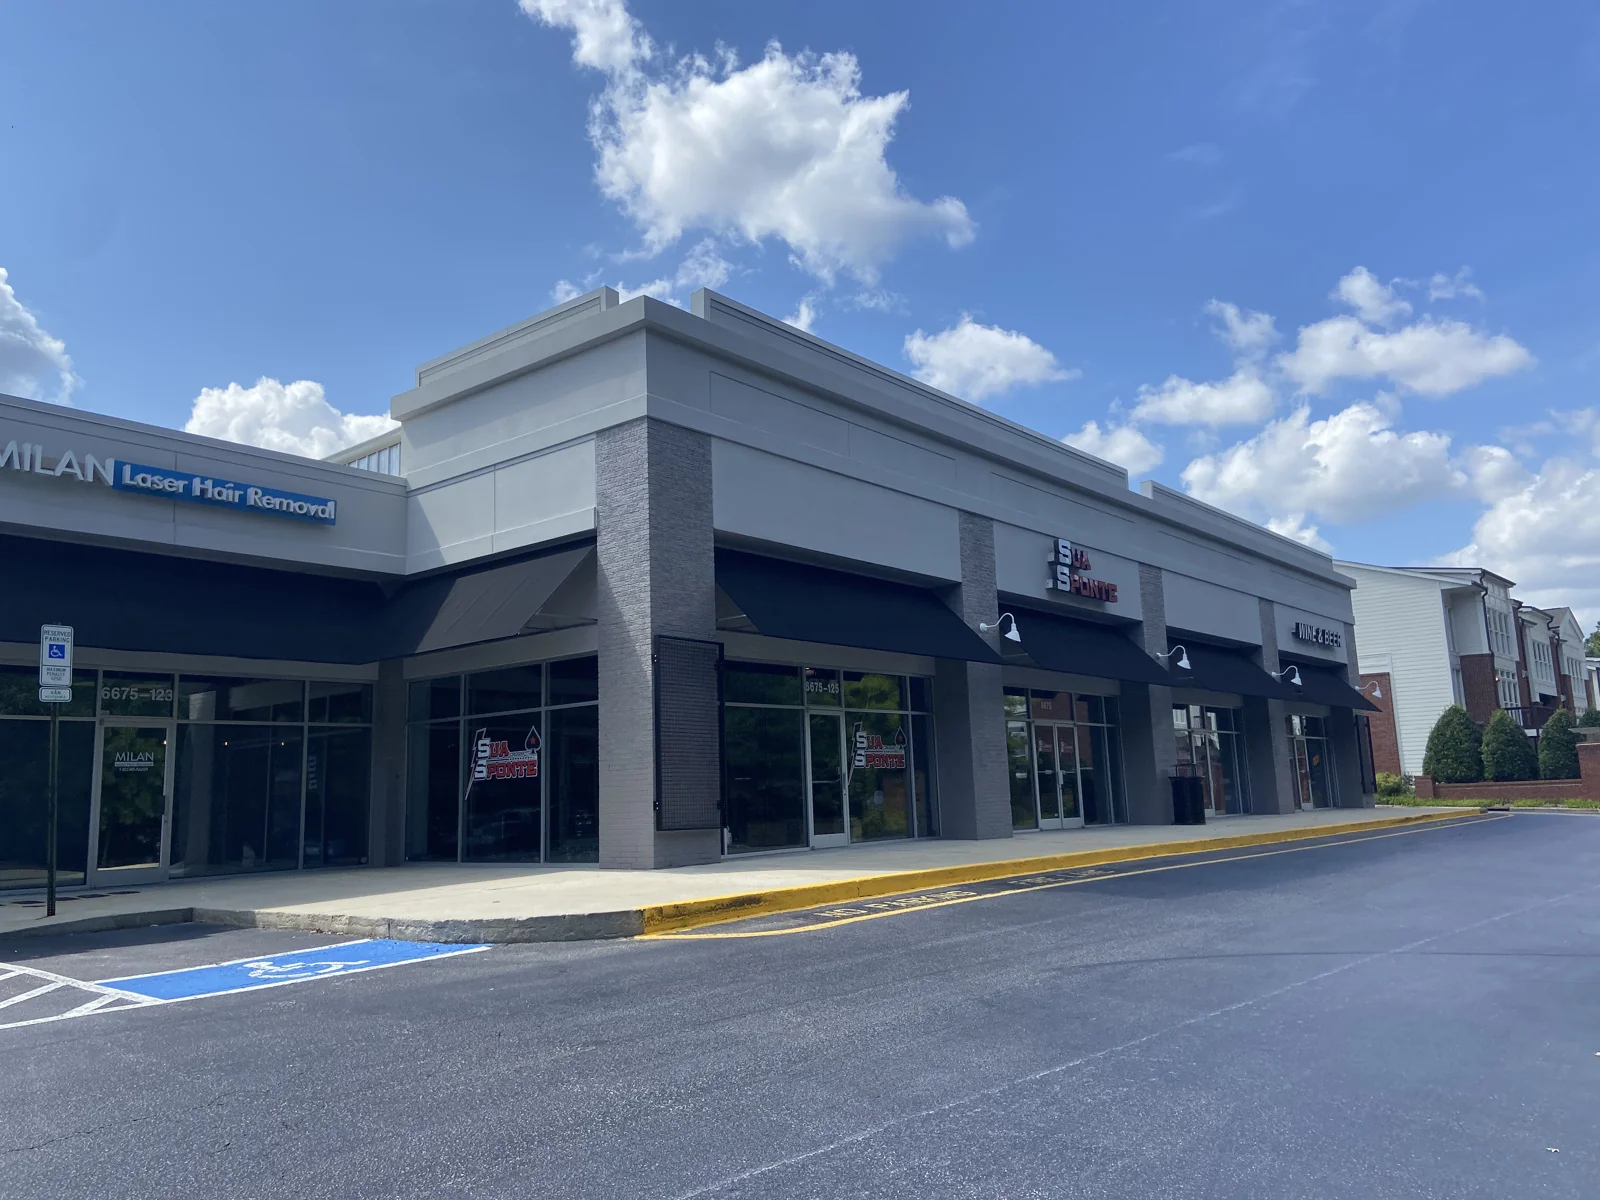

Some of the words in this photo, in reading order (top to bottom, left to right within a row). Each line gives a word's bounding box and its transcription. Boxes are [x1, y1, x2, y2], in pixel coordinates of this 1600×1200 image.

[122, 464, 188, 494] Laser
[192, 477, 244, 503] Hair
[247, 487, 336, 520] Removal
[1057, 538, 1092, 571] SUA
[1056, 564, 1118, 603] SPONTE
[1297, 622, 1317, 641] WINE
[1324, 629, 1341, 648] BEER
[101, 687, 172, 701] 6675-123
[477, 738, 510, 760] SUA
[854, 731, 883, 751] SUA
[115, 751, 154, 762] MILAN
[854, 750, 905, 768] SPONTE
[474, 759, 538, 780] SPONTE
[813, 908, 868, 918] NO
[863, 890, 978, 910] PARKING
